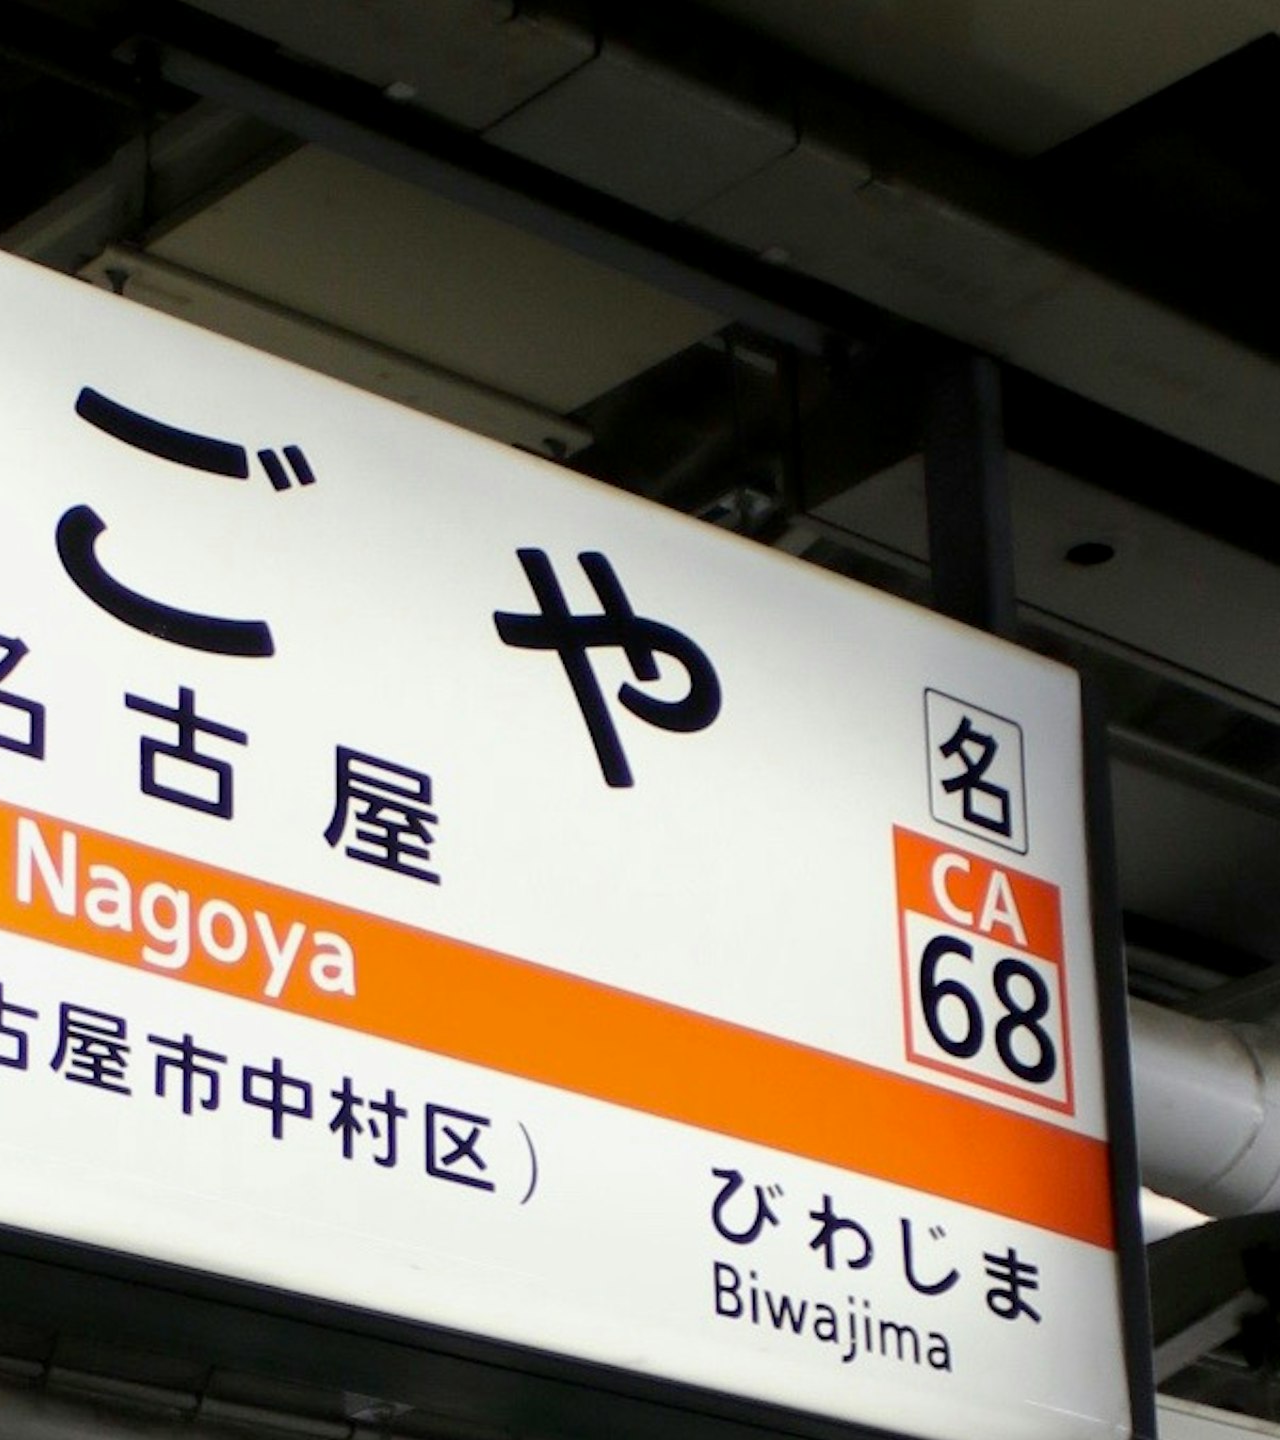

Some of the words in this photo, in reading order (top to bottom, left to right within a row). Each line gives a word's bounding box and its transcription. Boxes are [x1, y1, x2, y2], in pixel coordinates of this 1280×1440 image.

[938, 716, 1016, 842] 名
[12, 816, 360, 1001] Nagoya
[928, 853, 1029, 948] CA
[918, 933, 1059, 1086] 68
[709, 1165, 1044, 1324] びわじま
[711, 1263, 955, 1374] Biwajima
